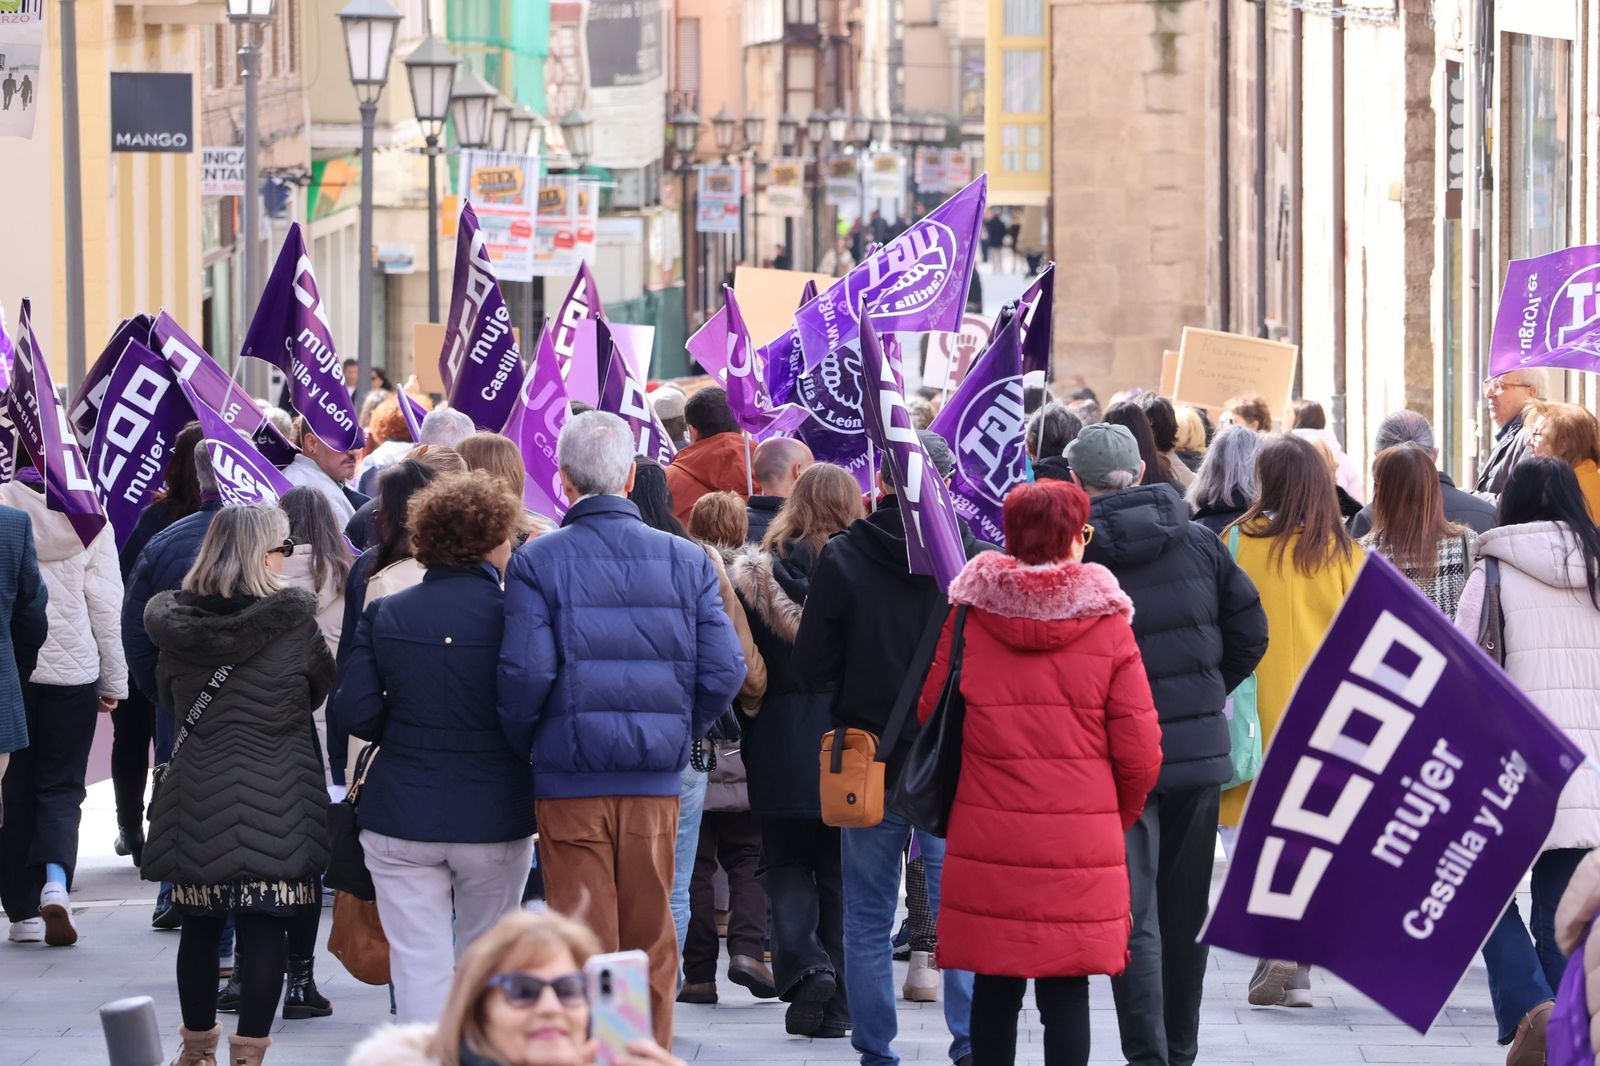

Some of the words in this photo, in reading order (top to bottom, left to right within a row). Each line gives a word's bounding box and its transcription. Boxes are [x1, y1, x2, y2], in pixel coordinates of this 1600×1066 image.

[1, 15, 31, 24] RZO
[115, 132, 188, 148] MANGO
[469, 298, 510, 365] muje
[308, 382, 321, 398] y
[319, 391, 354, 432] León
[825, 410, 862, 429] León
[123, 430, 166, 505] mujer
[185, 691, 213, 726] BIMBA
[1246, 608, 1448, 921] CCOO
[1481, 749, 1528, 811] León
[1371, 737, 1464, 868] mujer
[1473, 804, 1504, 836] y
[1402, 829, 1488, 940] Castilla
